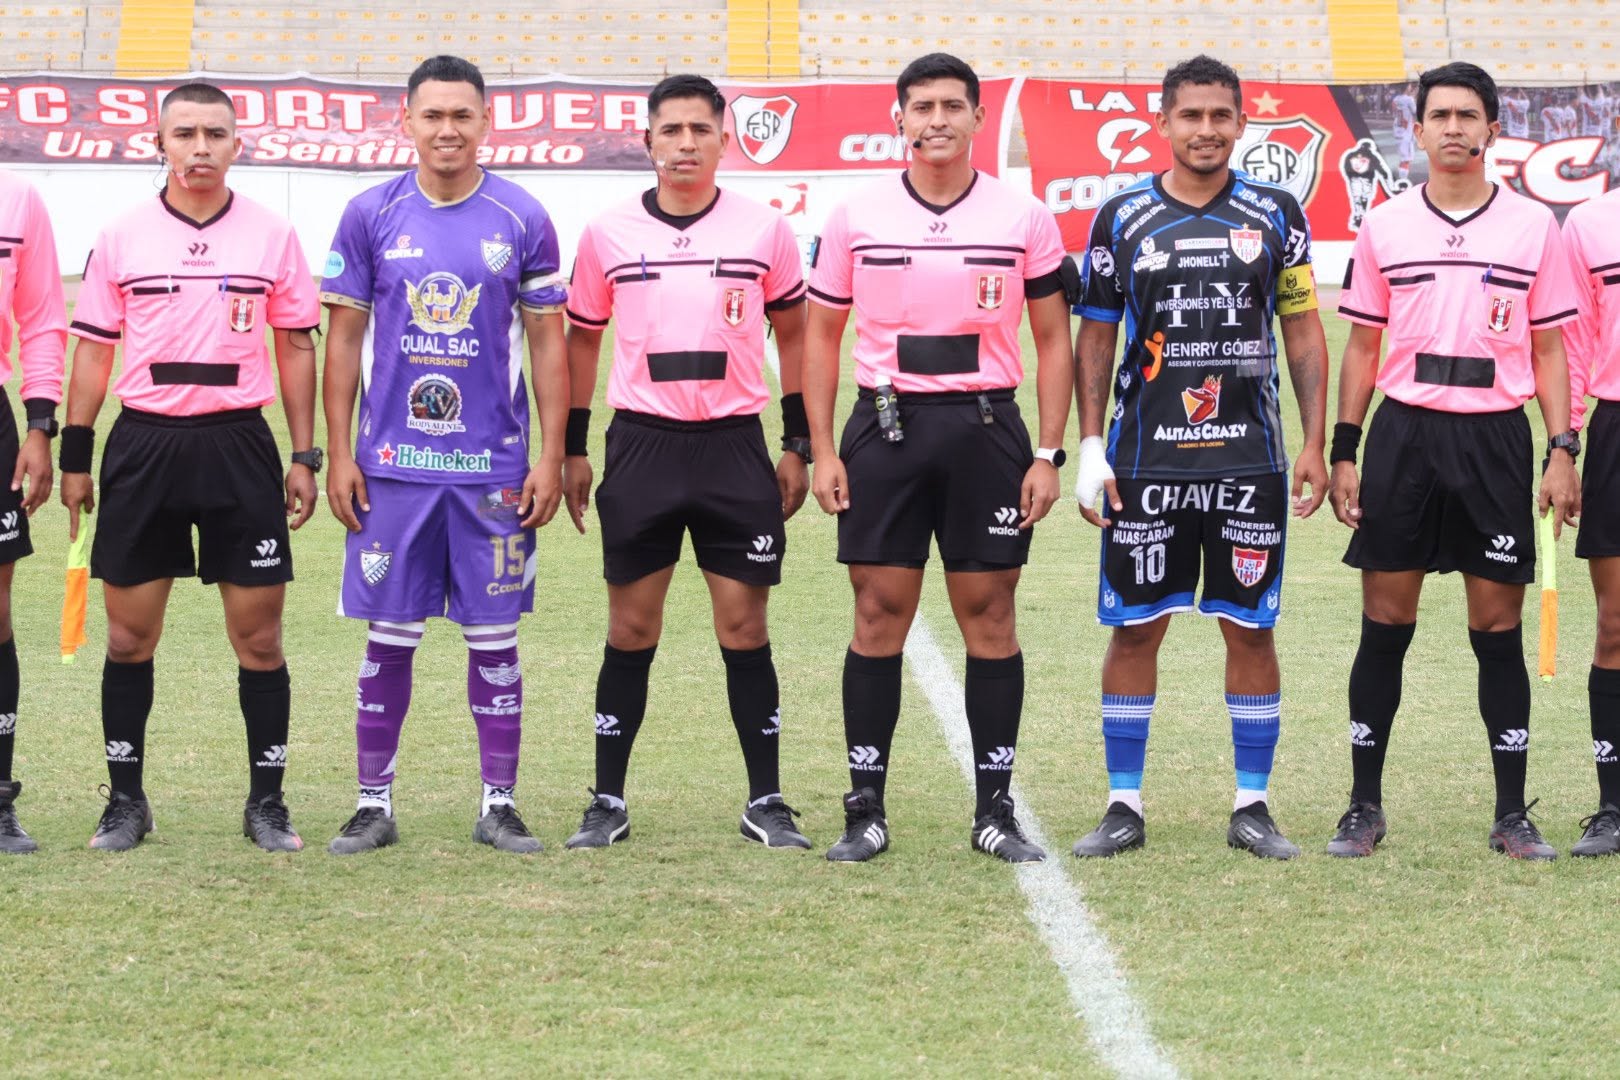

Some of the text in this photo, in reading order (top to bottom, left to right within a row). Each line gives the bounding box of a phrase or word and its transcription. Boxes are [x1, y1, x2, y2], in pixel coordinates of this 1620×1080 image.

[1069, 89, 1137, 112] LA
[98, 88, 377, 131] SORT
[44, 131, 113, 158] Un
[253, 133, 585, 165] Sentiento
[1045, 171, 1154, 214] CON
[1440, 250, 1469, 259] walon
[181, 258, 215, 267] walon
[1177, 255, 1220, 268] JHONELL
[1155, 298, 1210, 313] INVERSIONES
[1211, 297, 1235, 309] YELSI
[401, 335, 480, 357] QUIAL SAC
[1162, 341, 1219, 358] JENRRY
[408, 355, 469, 368] INVERSIONES
[1167, 360, 1191, 368] ASESOR
[398, 445, 491, 472] Heineken
[1226, 518, 1276, 531] MADERERA
[1113, 525, 1175, 545] HUASCARAN
[1221, 526, 1281, 546] HUASCARAN
[250, 556, 281, 568] walon
[490, 533, 526, 579] 15
[747, 552, 777, 563] walon
[1485, 550, 1518, 563] walon
[1129, 543, 1166, 585] 10
[594, 728, 621, 736] alon
[1351, 737, 1376, 747] alon
[256, 759, 287, 768] walo
[1594, 753, 1618, 763] lon
